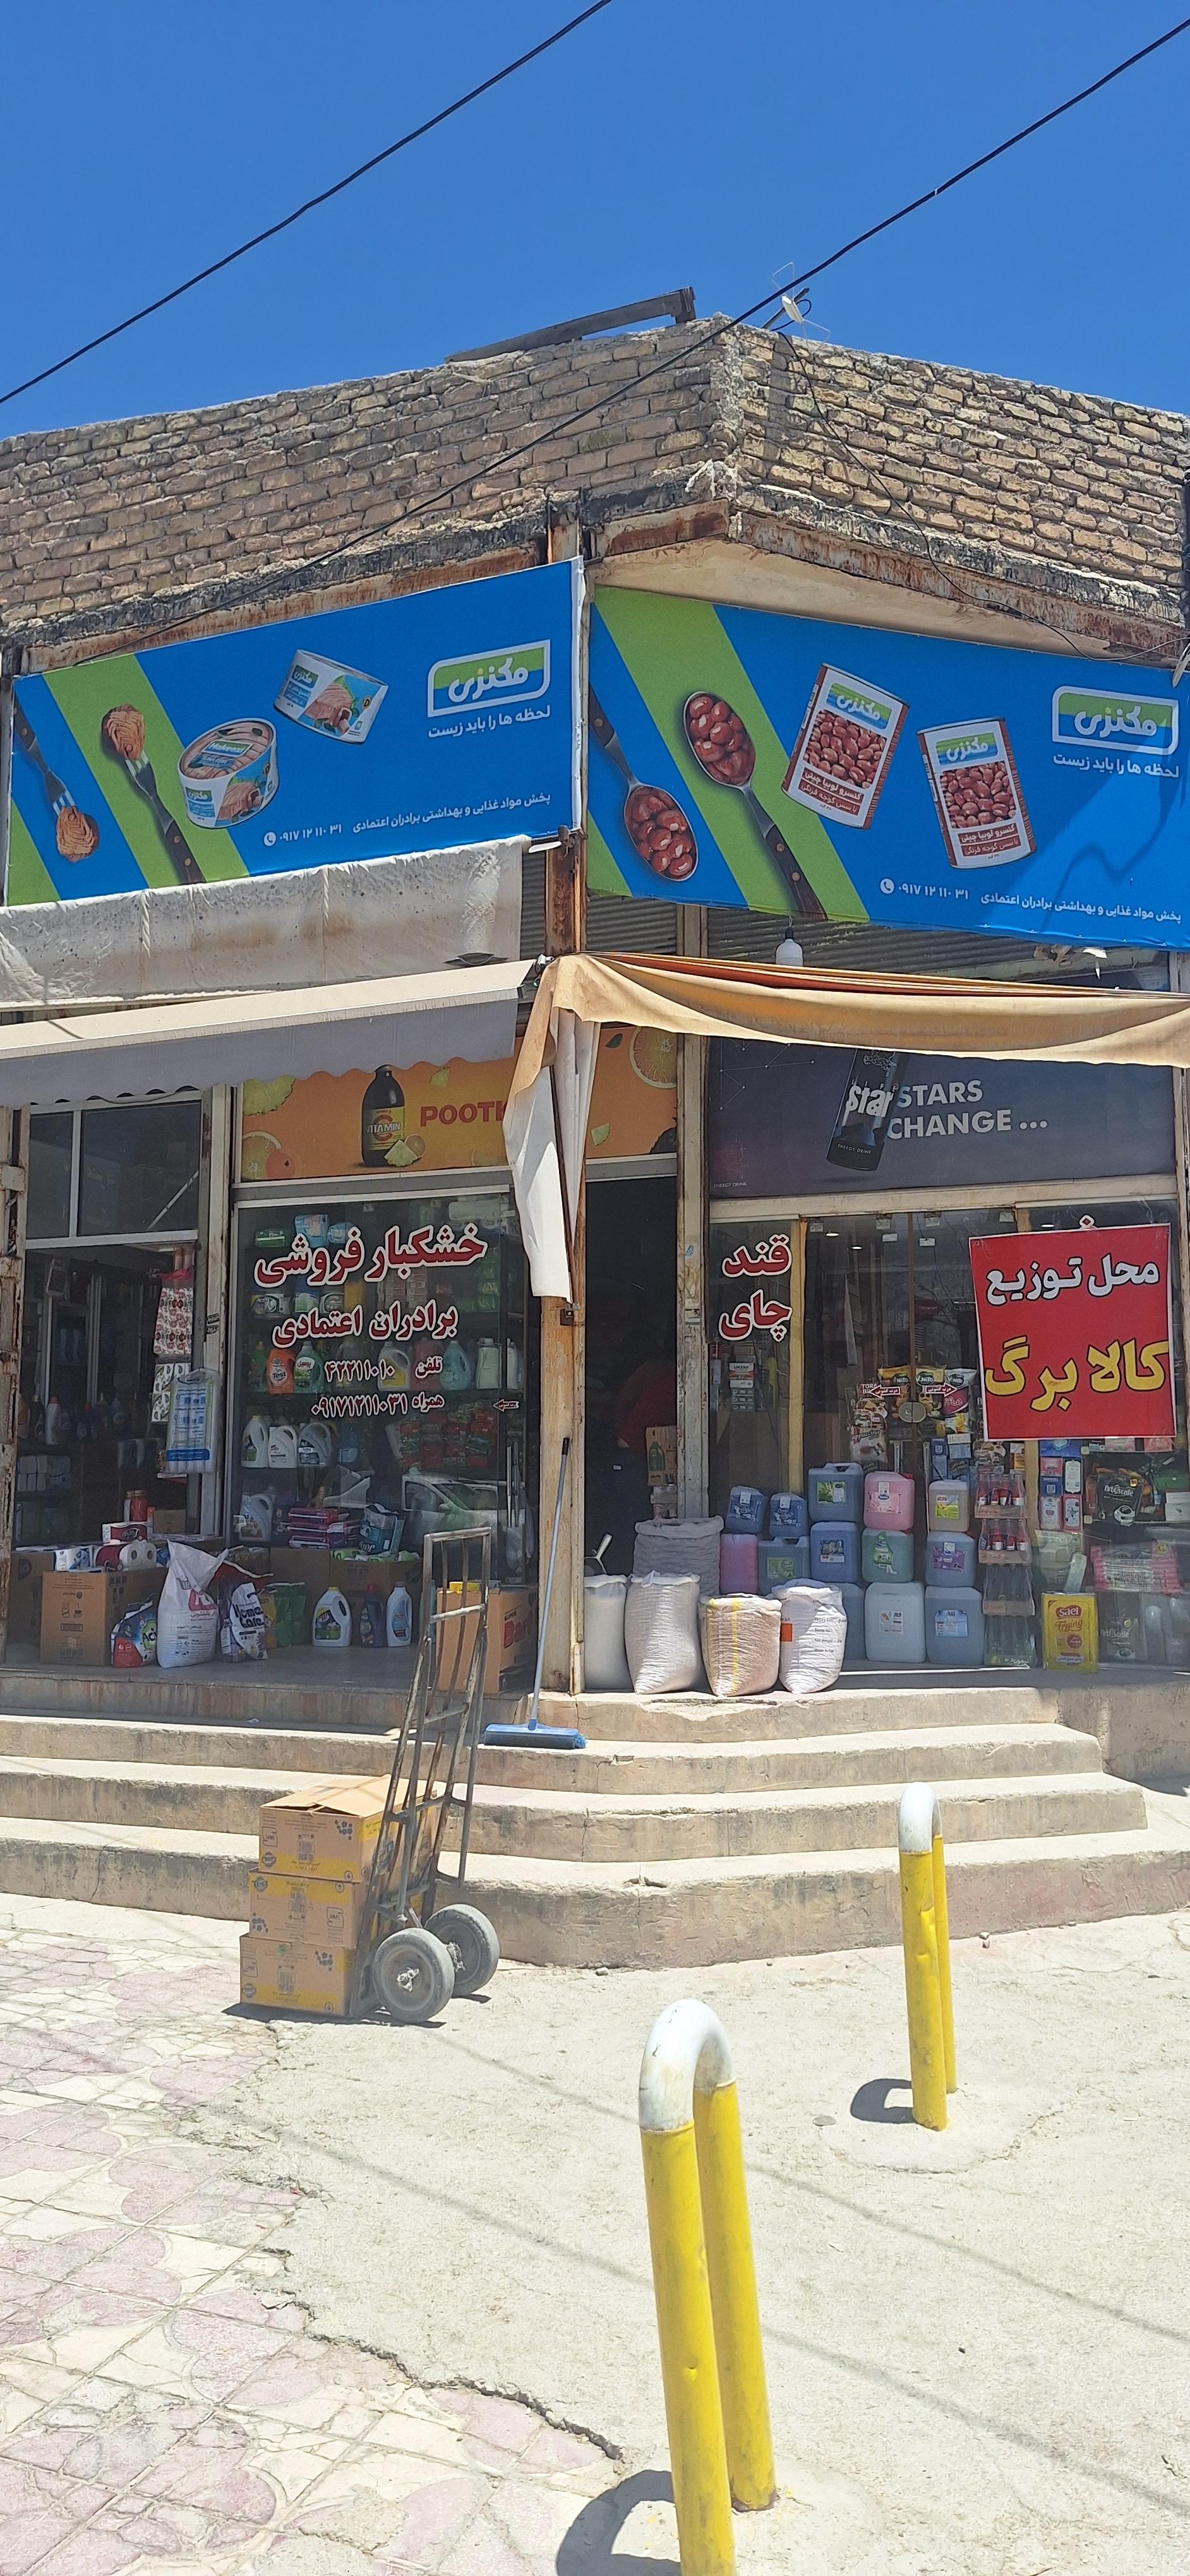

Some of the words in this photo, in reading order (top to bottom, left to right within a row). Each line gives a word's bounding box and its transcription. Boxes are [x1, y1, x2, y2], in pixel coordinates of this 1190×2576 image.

[448, 657, 529, 703] مکنزی
[515, 705, 551, 723] لحظه
[836, 695, 881, 721] مکنزی
[466, 717, 486, 734] باید
[488, 715, 496, 730] را
[498, 713, 513, 725] ها
[1074, 705, 1157, 738] مکنزی
[428, 722, 463, 737] زیست
[946, 737, 989, 761] مکنزی
[1053, 754, 1090, 770] زیست
[1093, 757, 1114, 774] باید
[1116, 758, 1124, 775] را
[1127, 760, 1141, 774] ها
[1144, 763, 1179, 778] لحظه
[472, 799, 499, 814] غذایی
[500, 797, 522, 810] مواد
[524, 792, 551, 808] پخش
[390, 813, 420, 828] برادران
[422, 807, 463, 823] بهداشتی
[465, 808, 471, 816] و
[303, 828, 313, 839] ۱۲
[330, 824, 342, 835] ۳۱
[352, 816, 389, 833] اعتمادی
[925, 886, 936, 896] ۱۲
[955, 888, 968, 900] ۳۱
[980, 893, 1019, 905] اعتمادی
[1021, 896, 1052, 910] برادران
[1054, 900, 1096, 915] بهداشتی
[1097, 907, 1104, 915] و
[1105, 905, 1132, 918] غذایی
[1133, 907, 1154, 919] مواد
[1155, 910, 1181, 925] پخش
[897, 1080, 983, 1108] STARS
[366, 1122, 400, 1134] VITAMIN
[887, 1109, 1011, 1140] CHANGE
[254, 1226, 365, 1288] فروشی
[364, 1223, 488, 1282] خشکبار
[721, 1234, 792, 1278] قند
[986, 1256, 1083, 1306] توزیع
[1087, 1253, 1160, 1297] محل
[369, 1299, 459, 1340] برادران
[718, 1289, 793, 1342] چای
[272, 1305, 363, 1349] اعتمادی
[325, 1359, 395, 1383] ۴۲۲۱۱۰۱۰
[415, 1356, 443, 1379] تلفن
[985, 1335, 1079, 1412] برگ
[1087, 1338, 1169, 1393] کالا
[311, 1393, 407, 1419] ۰۹۱۷۱۲۱۱۰۳۱
[411, 1391, 445, 1413] همراه
[232, 1604, 263, 1618] Home
[239, 1616, 264, 1628] Care
